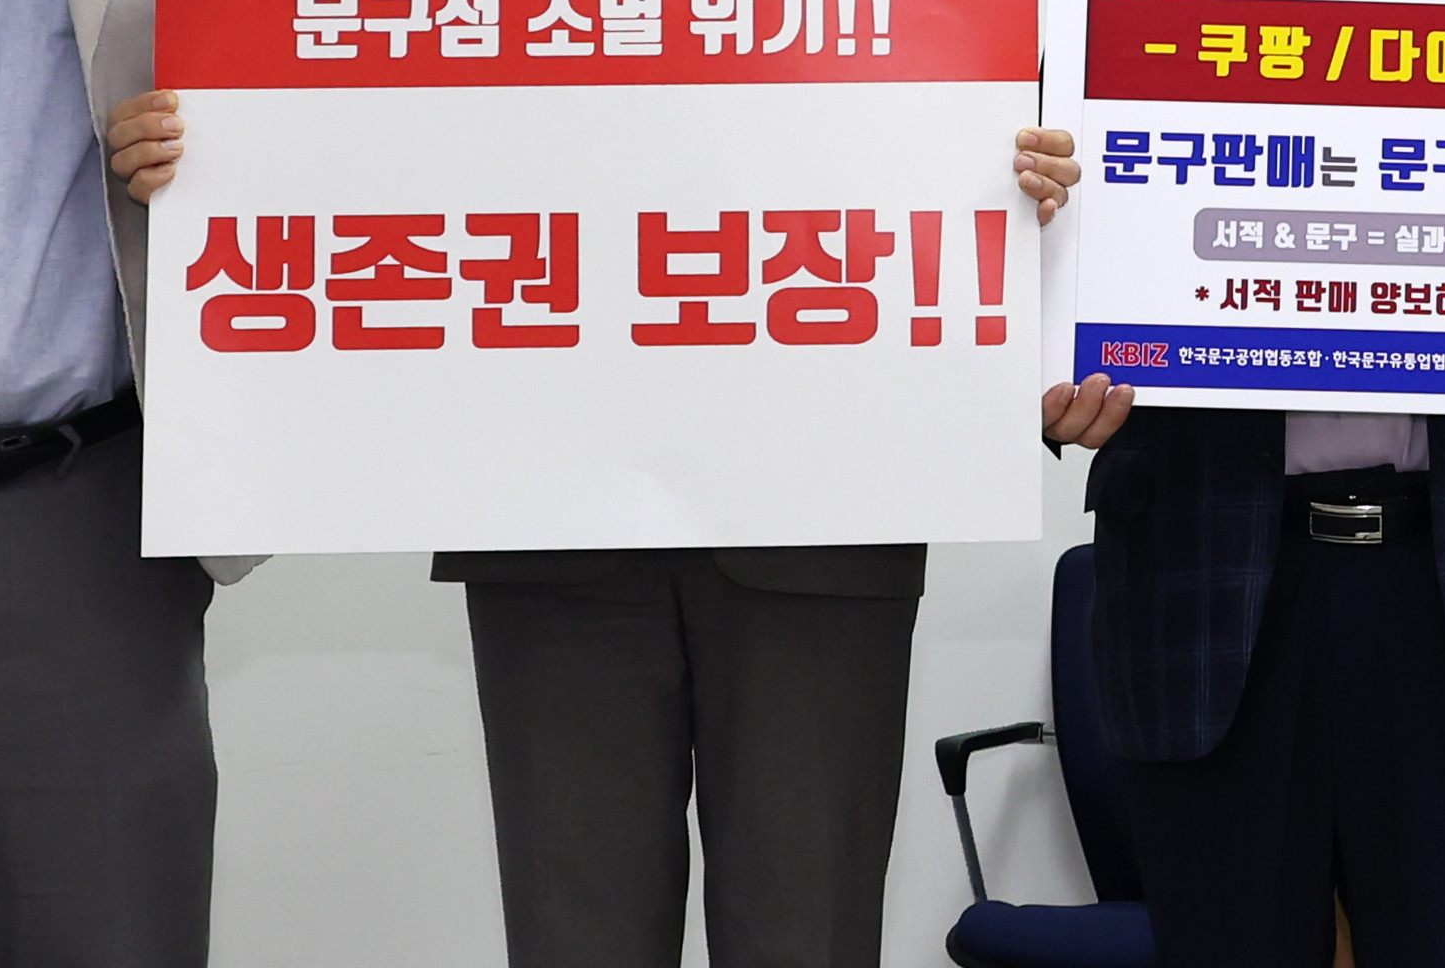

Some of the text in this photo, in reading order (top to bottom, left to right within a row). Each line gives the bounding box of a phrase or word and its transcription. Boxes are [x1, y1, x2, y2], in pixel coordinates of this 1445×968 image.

[1198, 24, 1312, 79] 쿠팡
[1102, 130, 1358, 188] 문구판매는
[1212, 220, 1264, 249] 서적
[1274, 222, 1296, 249] &
[1305, 222, 1358, 251] 문구
[186, 209, 1008, 353] 생존권 보장!!
[1220, 278, 1281, 312] 서적
[1295, 280, 1358, 313] 판매
[1178, 346, 1323, 368] 한국문구공업협동조합
